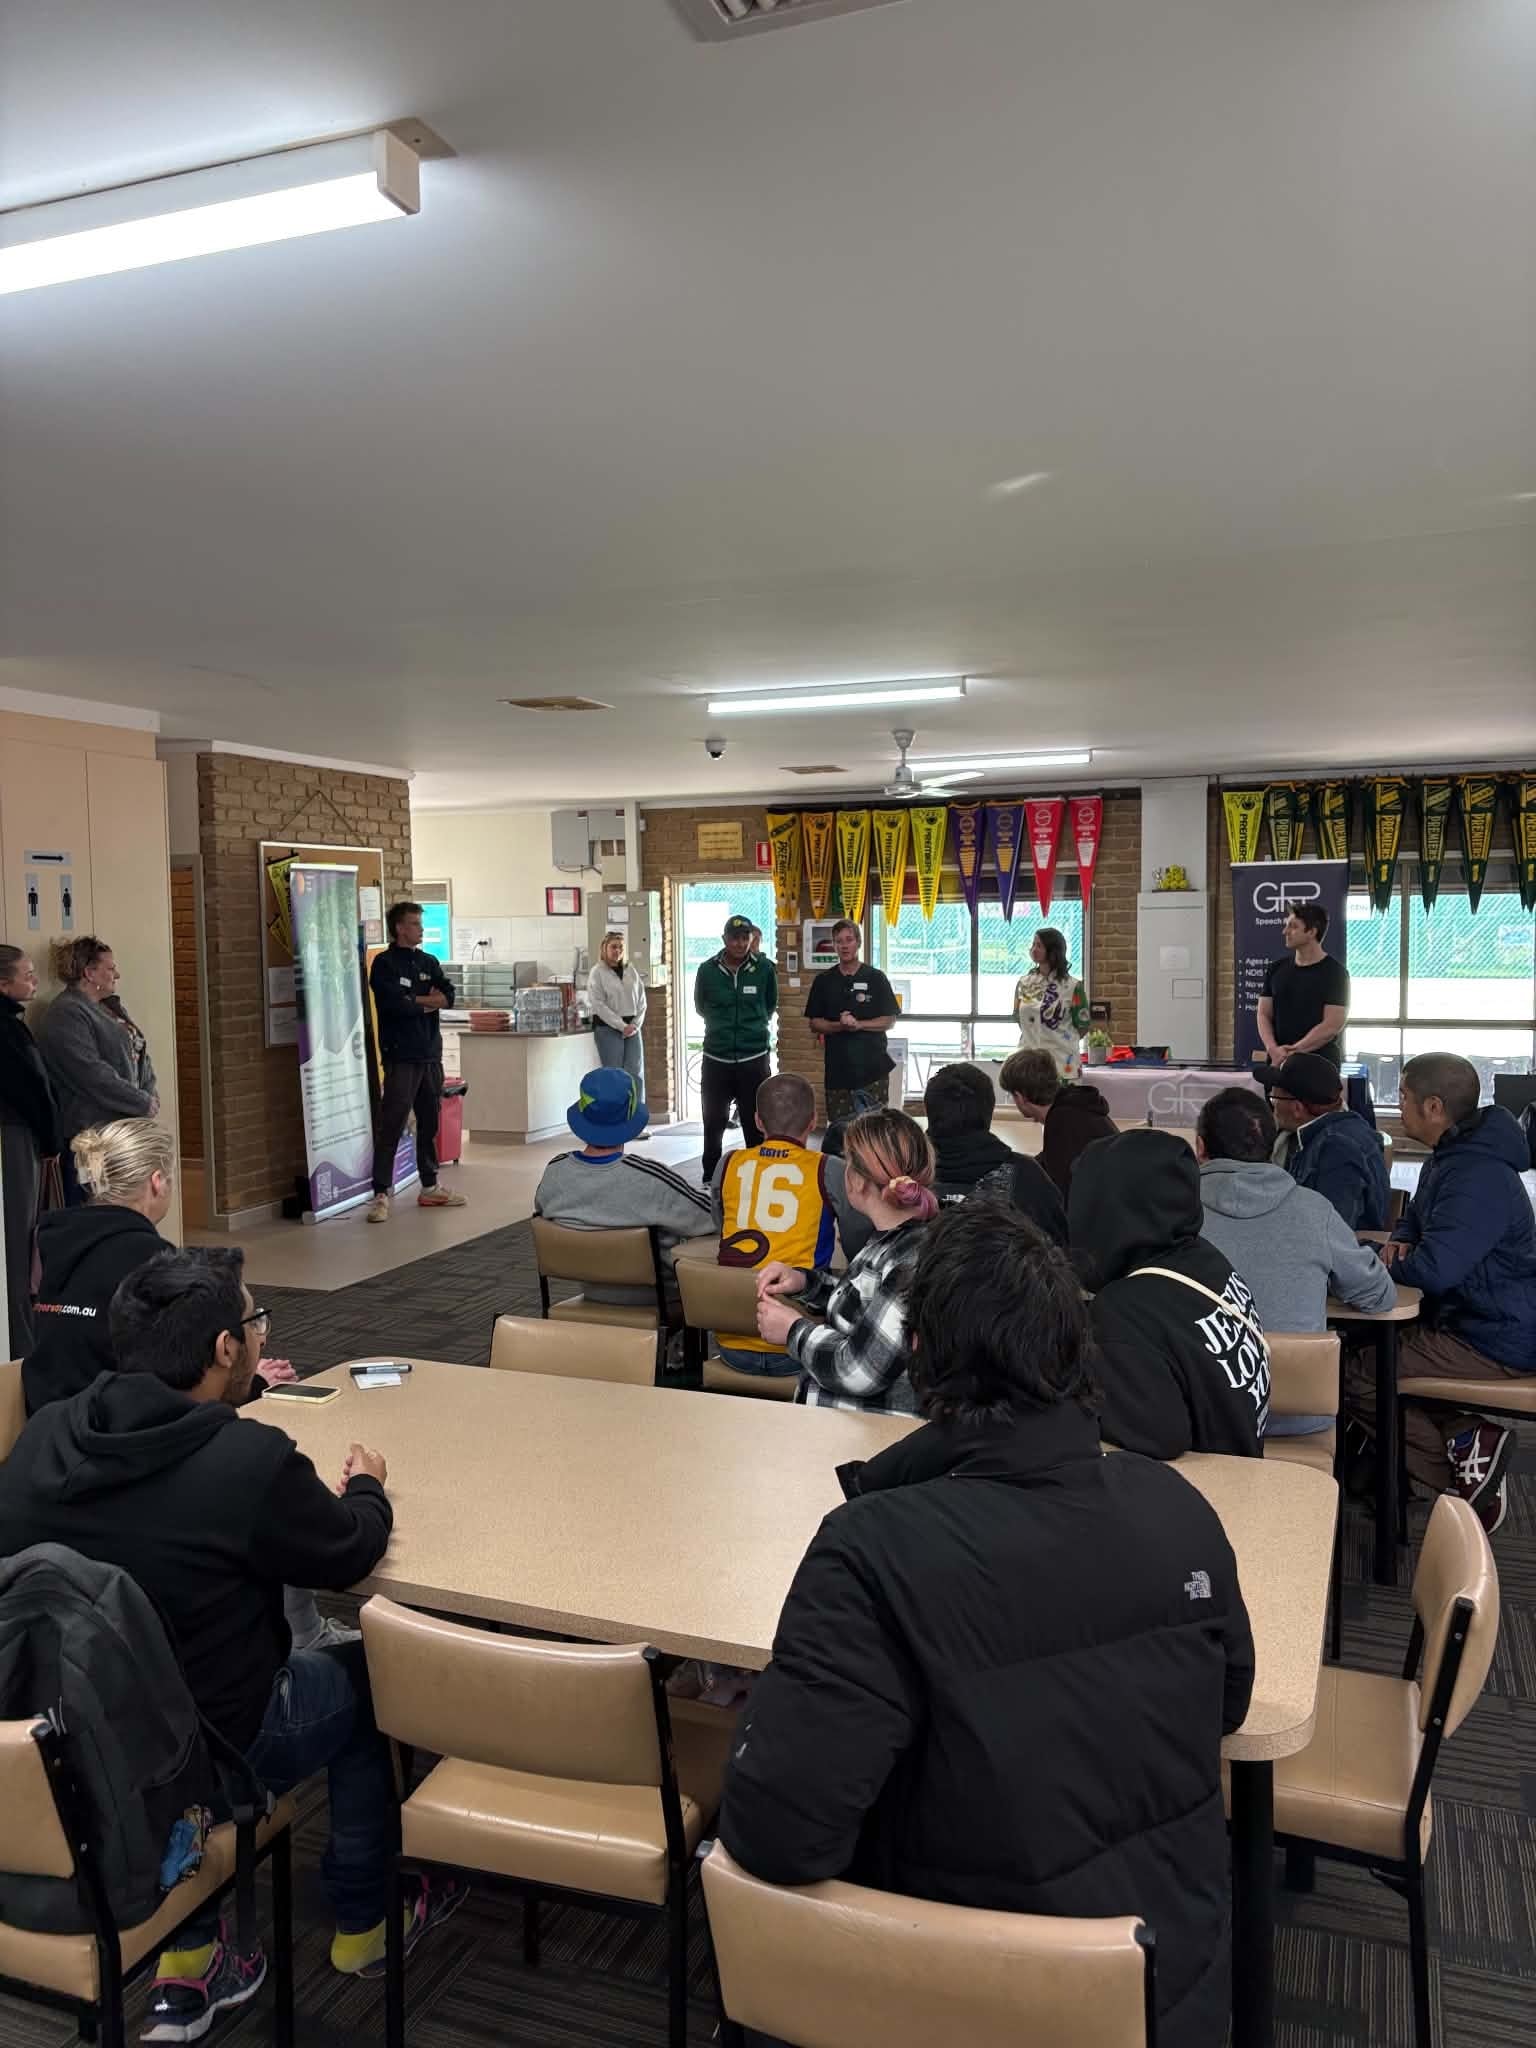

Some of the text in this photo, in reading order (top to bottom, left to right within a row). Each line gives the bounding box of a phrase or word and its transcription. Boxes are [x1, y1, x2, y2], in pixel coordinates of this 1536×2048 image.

[1239, 813, 1249, 863] PREMIERS
[1276, 819, 1289, 860] PREMIER
[1382, 816, 1394, 859] PREMIERS
[1428, 816, 1440, 860] PREMIERS
[1471, 814, 1484, 858] PREMIERS
[1255, 917, 1282, 925] Speech
[1245, 957, 1263, 966] Ages
[736, 1159, 804, 1232] 16
